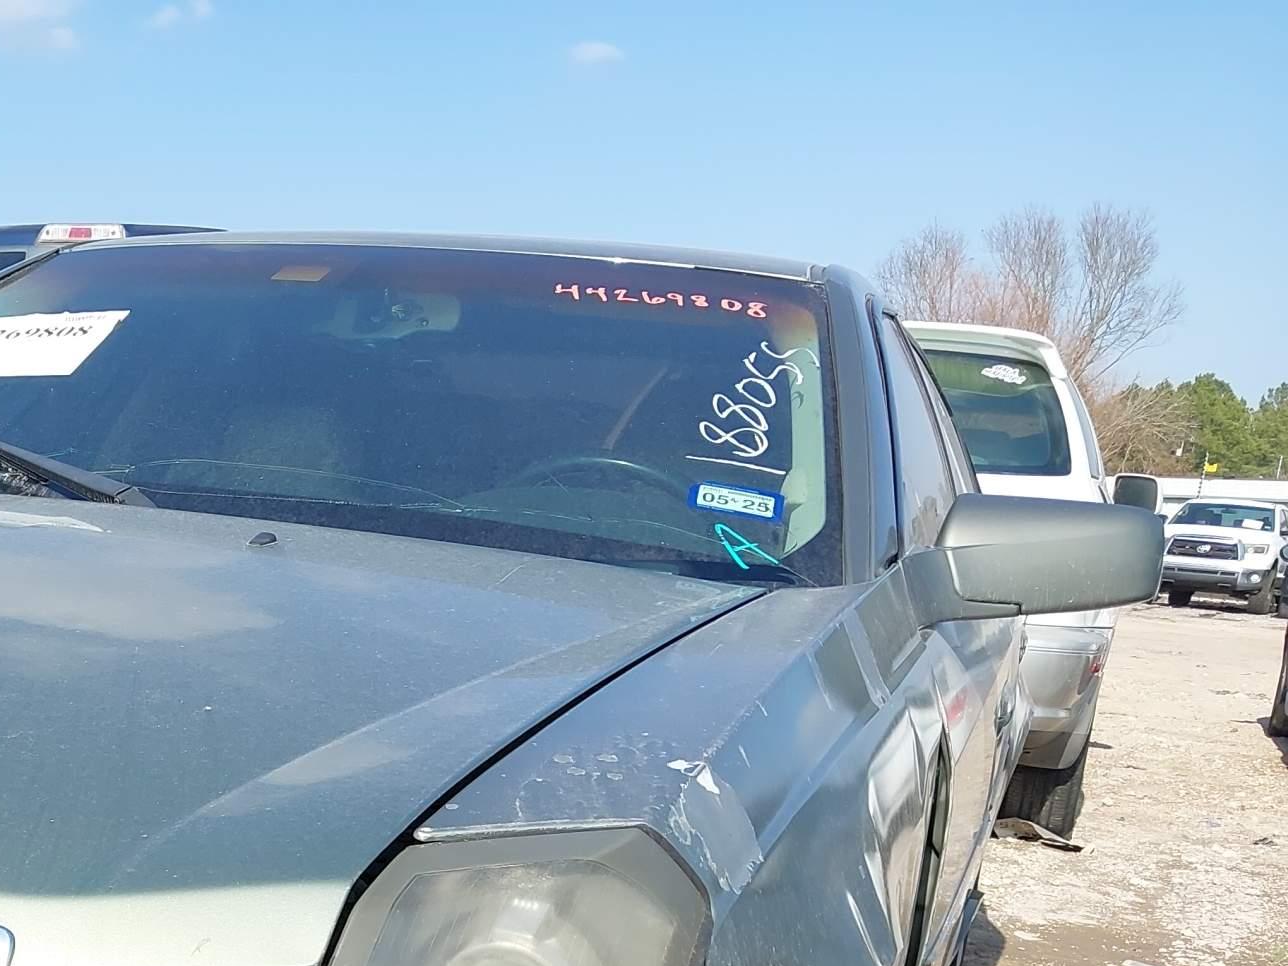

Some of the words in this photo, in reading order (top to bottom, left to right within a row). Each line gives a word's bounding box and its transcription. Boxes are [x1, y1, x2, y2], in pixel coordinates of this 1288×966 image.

[554, 283, 768, 318] 44269808
[702, 492, 729, 505] 05
[742, 499, 771, 513] 25
